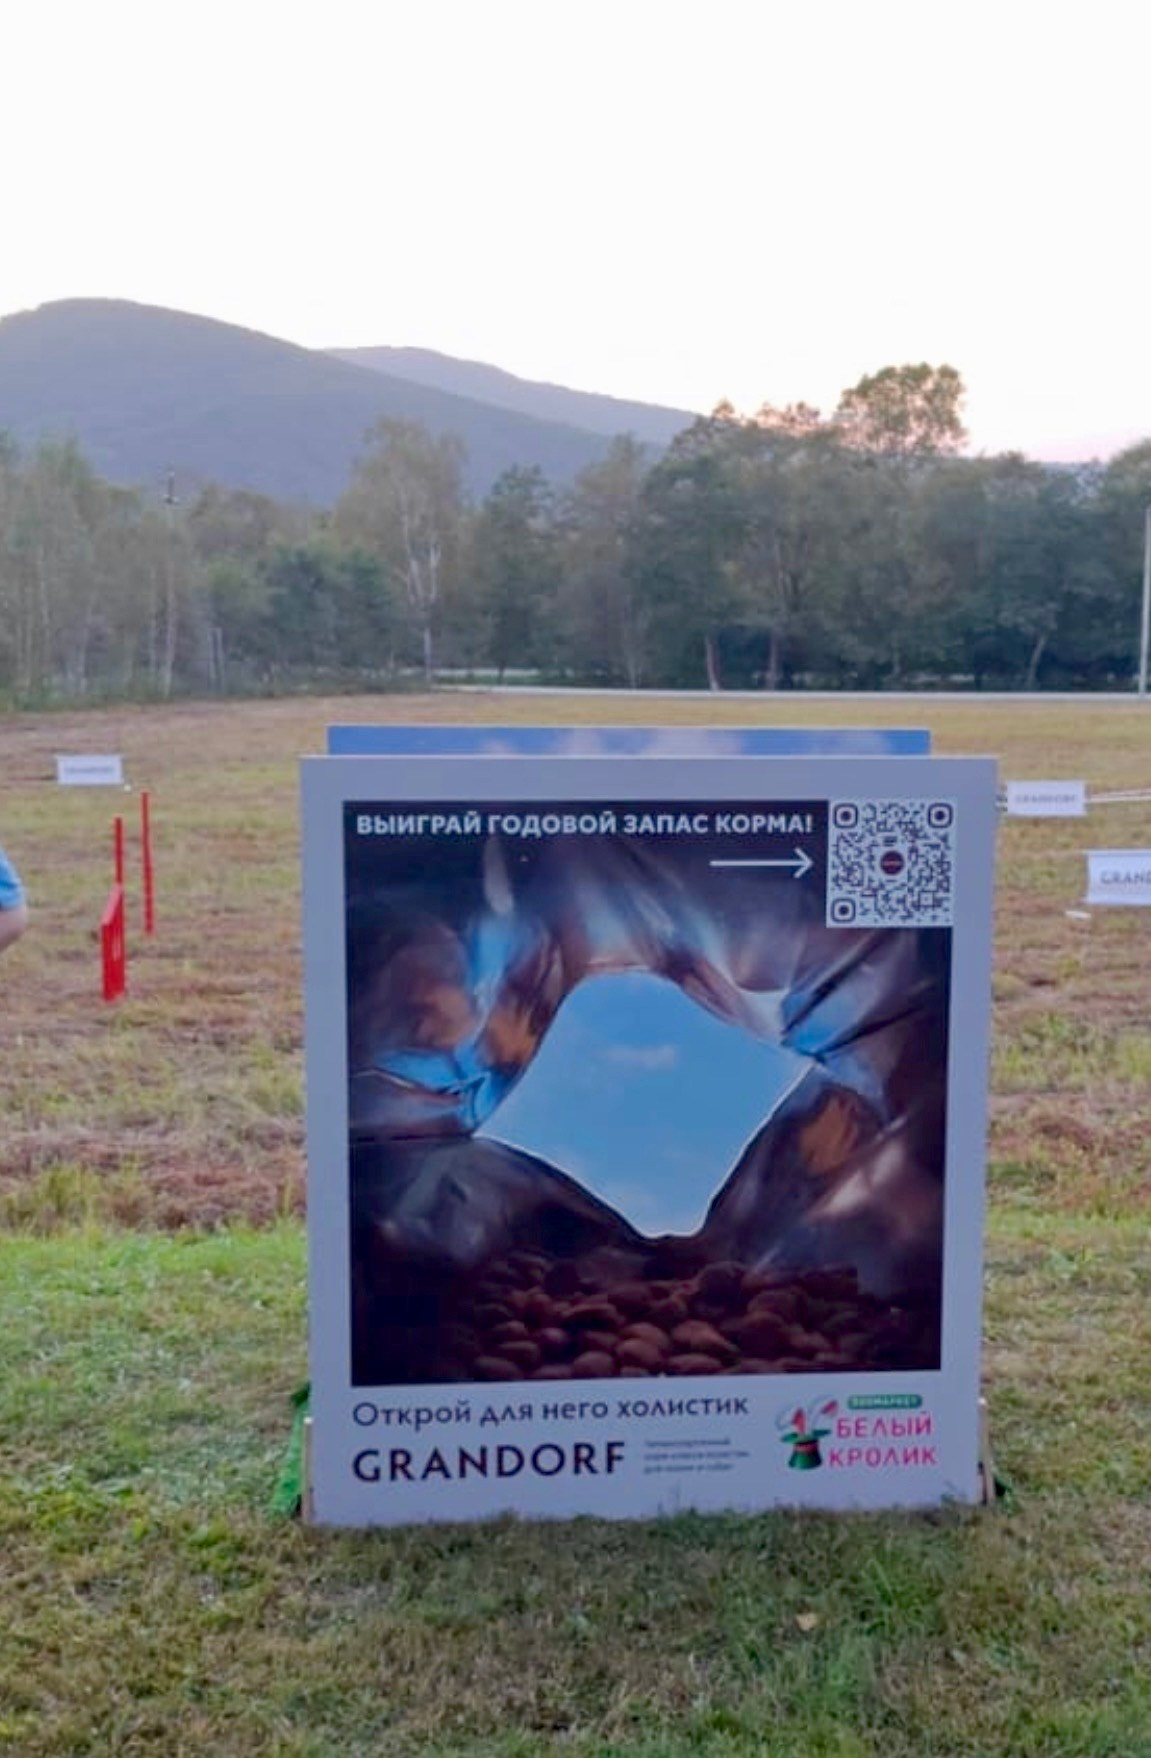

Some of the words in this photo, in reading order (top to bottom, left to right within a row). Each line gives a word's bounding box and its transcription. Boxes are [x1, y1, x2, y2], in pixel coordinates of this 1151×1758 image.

[356, 810, 481, 835] ВЫИГРАЙ
[487, 810, 617, 838] ГОДОВОЙ
[623, 814, 709, 834] ЗАПАС
[715, 813, 813, 834] КОРМА!
[353, 1400, 471, 1432] Открой
[480, 1404, 533, 1427] для
[542, 1401, 609, 1420] него
[617, 1397, 750, 1418] холистик
[836, 1410, 932, 1439] БЕЛЫЙ
[352, 1440, 625, 1483] GRANDORF
[828, 1446, 937, 1468] КРОЛИК
